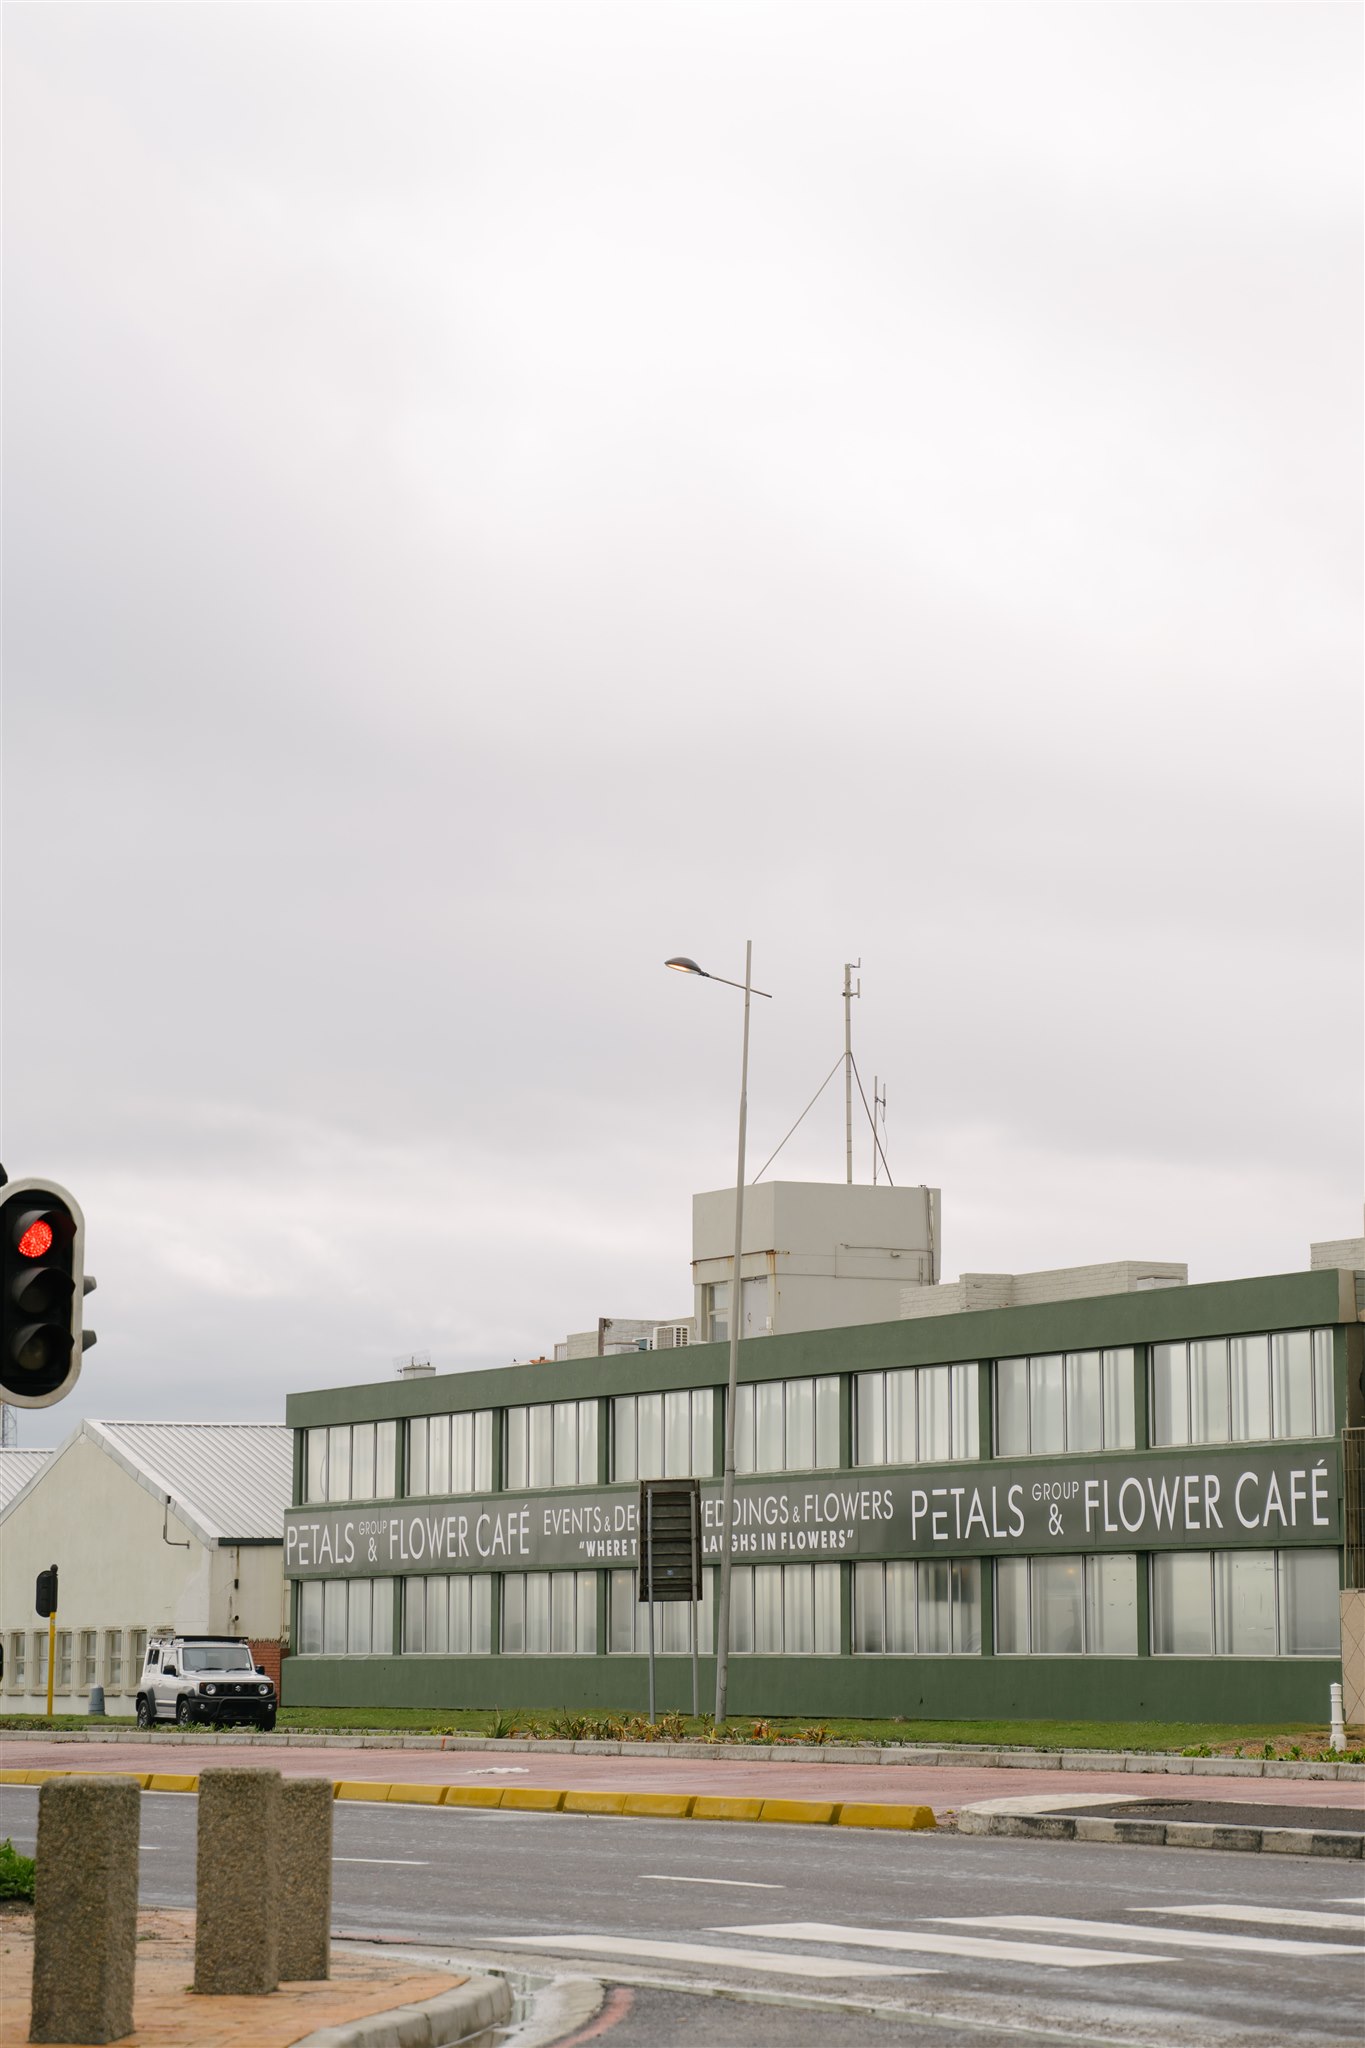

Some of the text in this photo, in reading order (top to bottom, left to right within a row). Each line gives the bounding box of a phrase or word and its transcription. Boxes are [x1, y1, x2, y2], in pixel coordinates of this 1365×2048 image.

[544, 1489, 894, 1535] EVENTS & DE EDDINGS & FLOWERS
[912, 1459, 1330, 1541] PETALS GROUP & FLOWER CAFÉ
[287, 1504, 530, 1565] PETALS GROUP & FLOWER CAFÉ
[579, 1539, 628, 1557] "WHERE
[761, 1532, 776, 1550] IN
[781, 1529, 854, 1550] FLOWERS"
